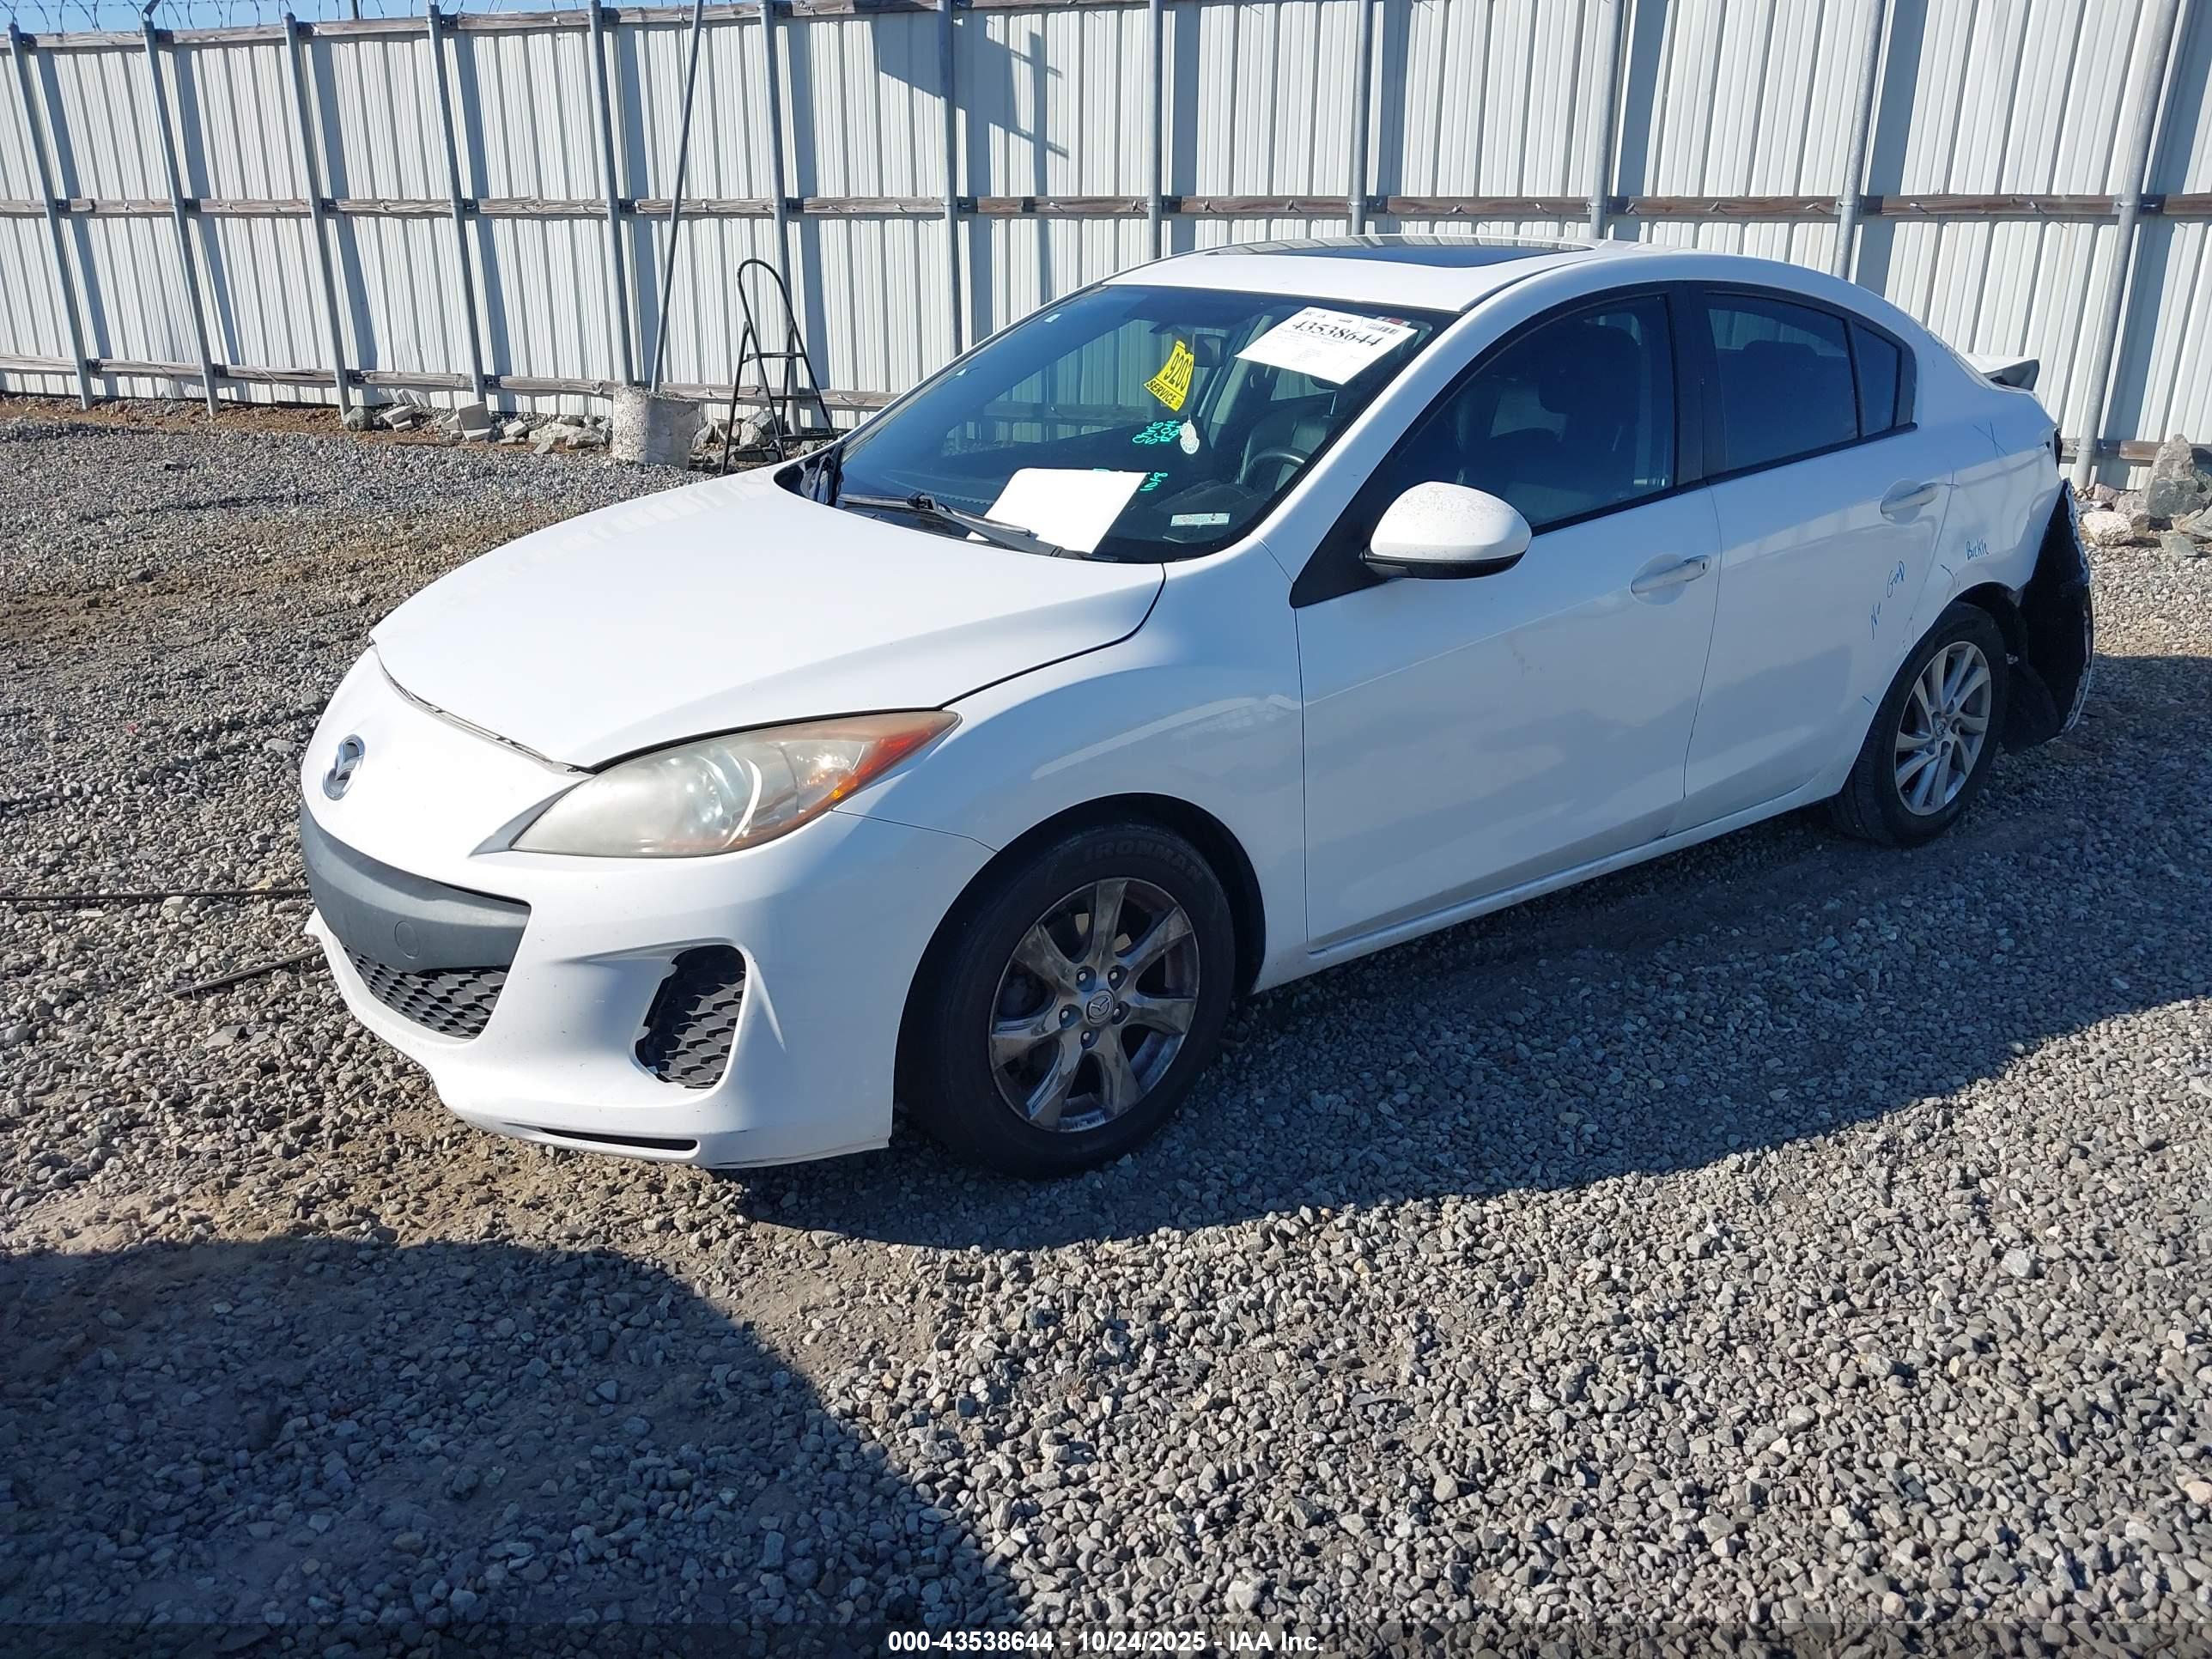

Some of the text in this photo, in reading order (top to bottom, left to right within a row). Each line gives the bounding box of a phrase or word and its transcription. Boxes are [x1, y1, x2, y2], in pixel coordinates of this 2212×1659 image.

[1291, 319, 1384, 347] 43538644
[1164, 351, 1193, 392] 9203
[1146, 380, 1176, 404] SERVICE
[1132, 421, 1164, 444] Chris
[1139, 471, 1168, 491] 10/8
